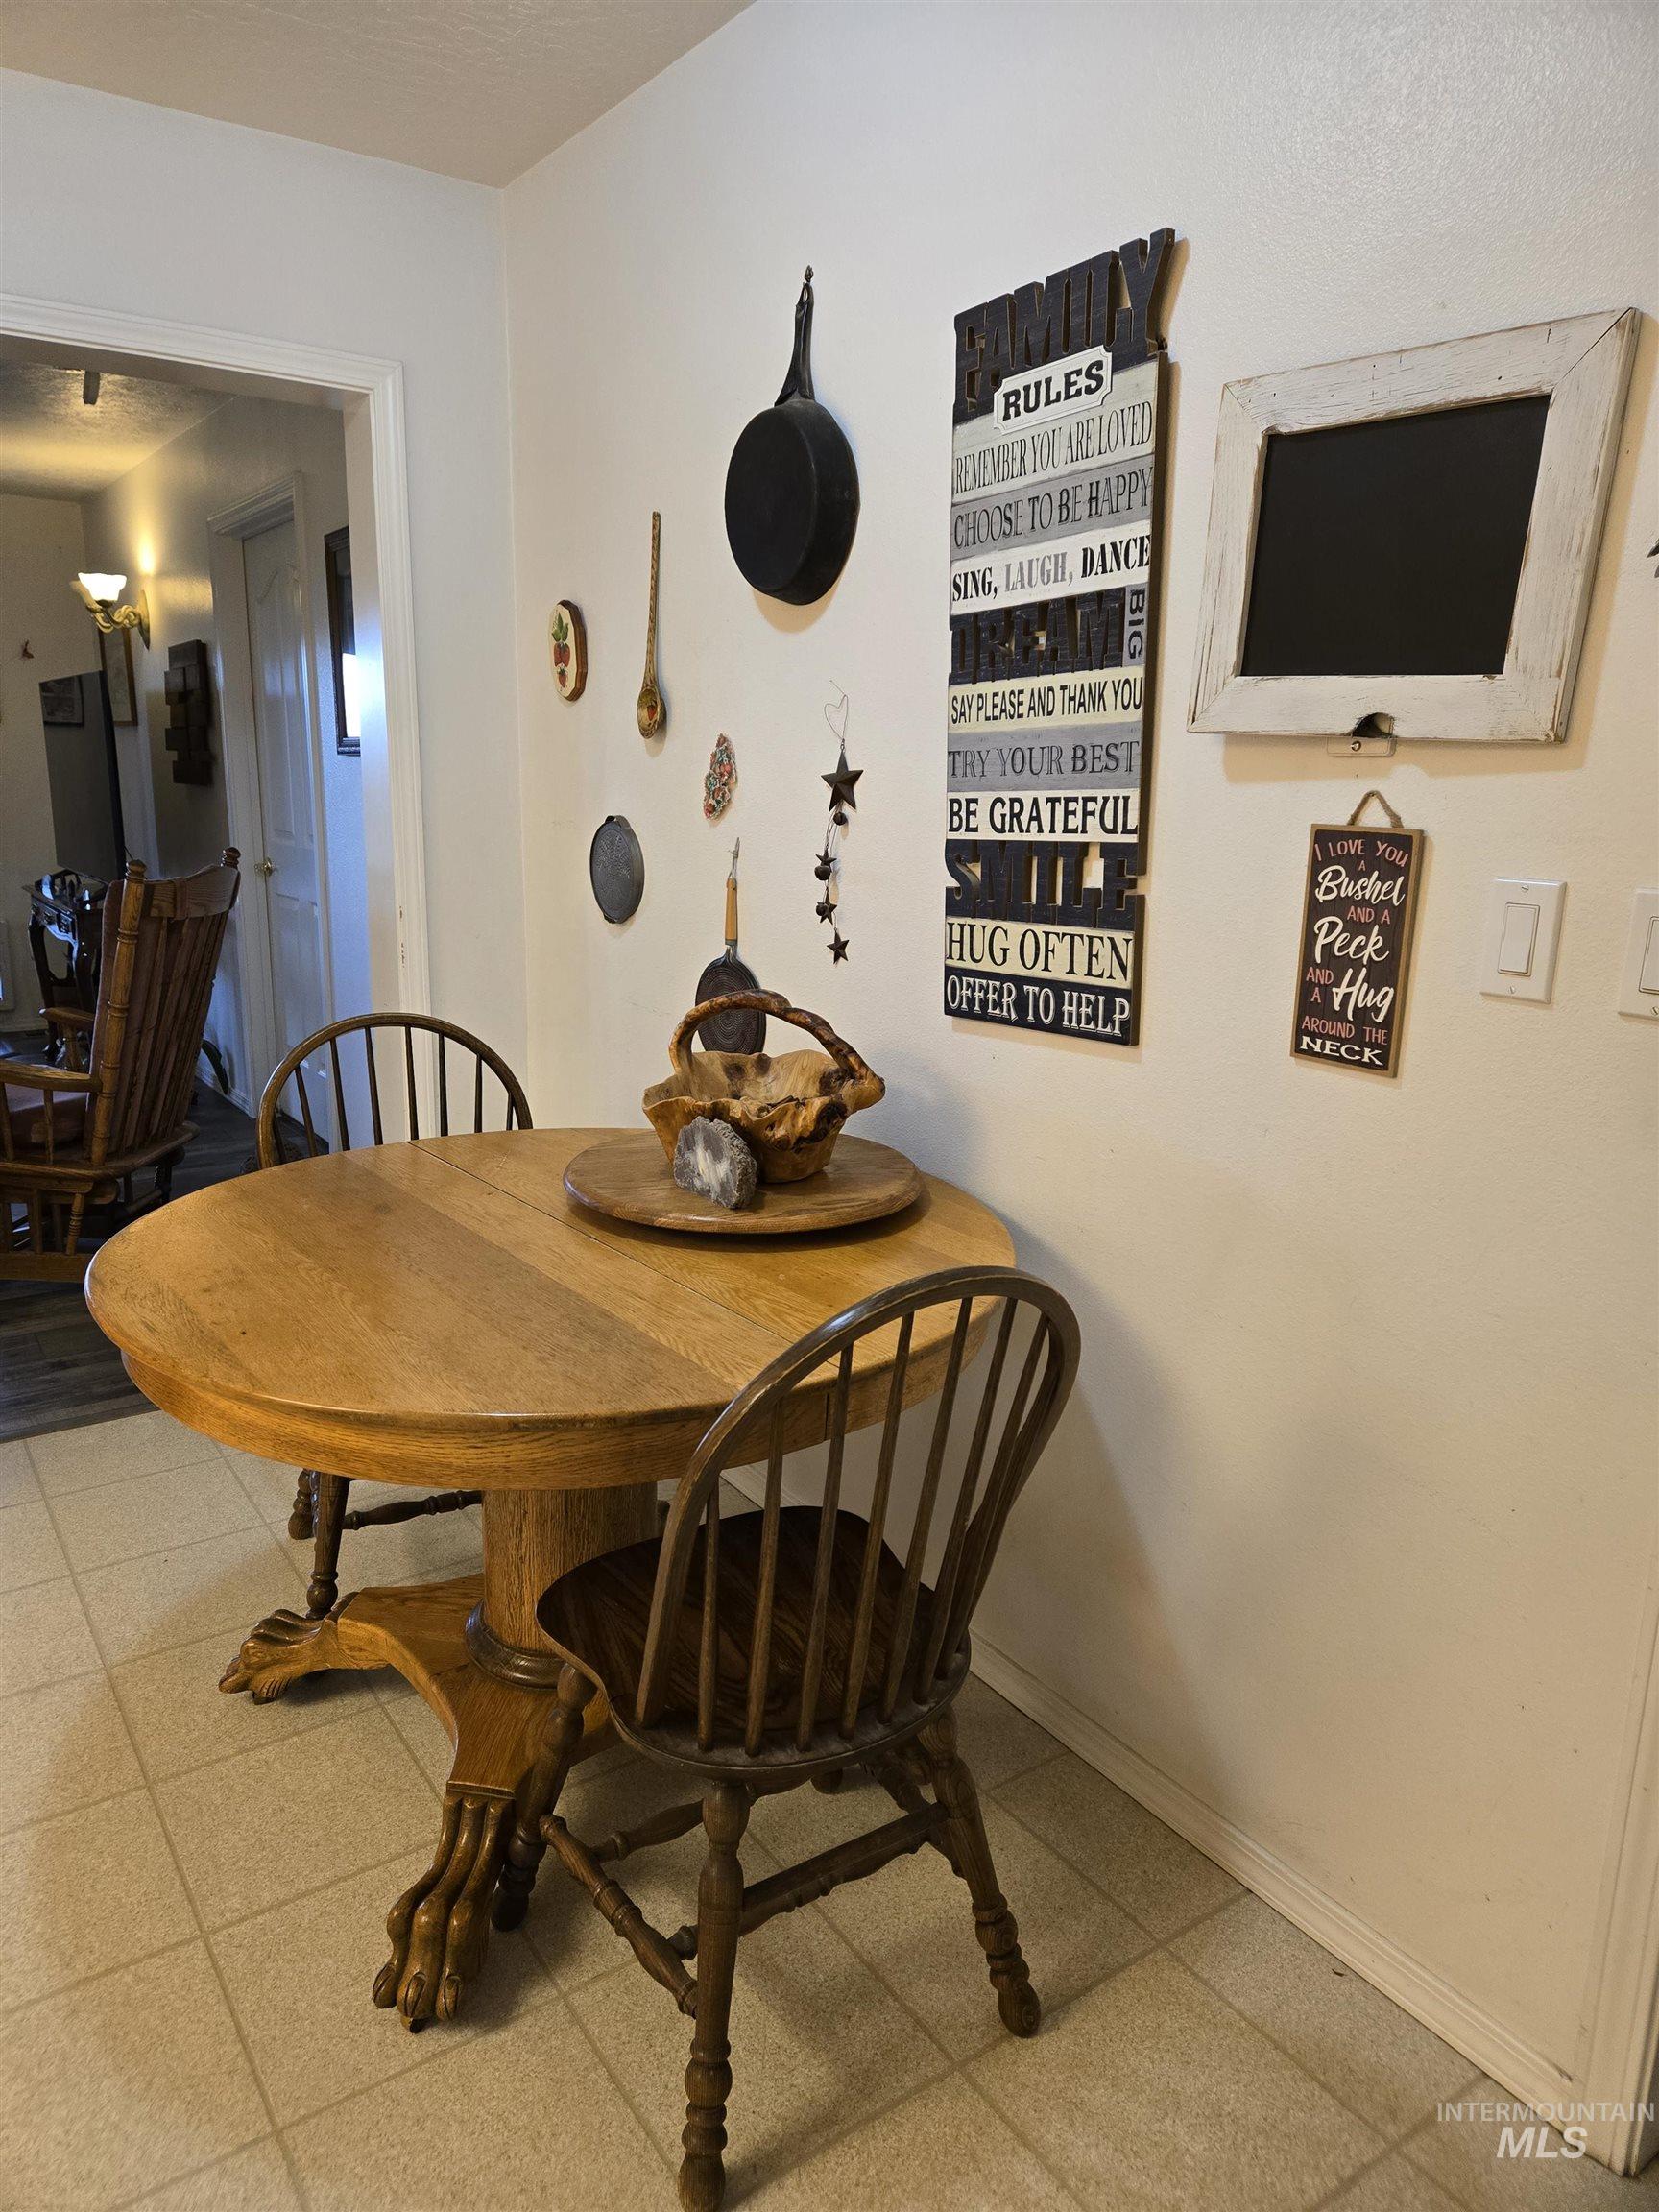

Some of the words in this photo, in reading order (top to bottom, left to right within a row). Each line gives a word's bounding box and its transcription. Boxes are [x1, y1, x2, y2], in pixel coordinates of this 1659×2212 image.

[953, 227, 1175, 424] FAMILY
[1002, 359, 1105, 421] RULES
[955, 438, 1027, 494] REMEMBER
[1031, 428, 1063, 472] YOU
[1065, 420, 1093, 466] ARE
[1097, 400, 1153, 455] LOVED
[954, 499, 1023, 549] CHOOSE
[1028, 493, 1053, 531] TO
[1058, 484, 1082, 524] BE
[1088, 467, 1154, 517] HAPPY
[952, 566, 998, 602] SING,
[1004, 552, 1073, 592] LAUGH,
[1081, 534, 1152, 578] DANCE
[949, 586, 1125, 685] DREAM
[1127, 588, 1145, 660] BIG
[950, 694, 974, 724] SAY
[976, 689, 1024, 722] PLEASE
[1027, 685, 1055, 718] AND
[1060, 681, 1108, 715] THANK
[1112, 677, 1143, 710] YOU
[948, 749, 991, 779] TRY
[996, 745, 1064, 778] YOUR
[1070, 741, 1140, 775] BEST
[949, 798, 979, 833] BE
[989, 795, 1139, 834] GRATEFUL
[1314, 843, 1322, 861] I
[1328, 839, 1365, 857] LOVE
[1376, 841, 1408, 868] YOU
[1358, 860, 1366, 872] A
[945, 839, 1141, 931] SMILE
[1315, 865, 1405, 906] Bushel
[1313, 916, 1389, 964] Peck
[1347, 905, 1374, 923] AND
[1381, 909, 1390, 925] A
[946, 922, 1010, 966] HUG
[1019, 928, 1133, 982] OFTEN
[947, 975, 1018, 1022] OFFER
[1023, 985, 1055, 1024] TO
[1062, 991, 1131, 1037] HELP
[1306, 967, 1334, 985] AND
[1333, 967, 1394, 1022] Hug
[1310, 987, 1321, 1003] A
[1300, 1035, 1383, 1066] NECK
[1302, 1015, 1355, 1038] AROUND
[1363, 1026, 1388, 1046] THE
